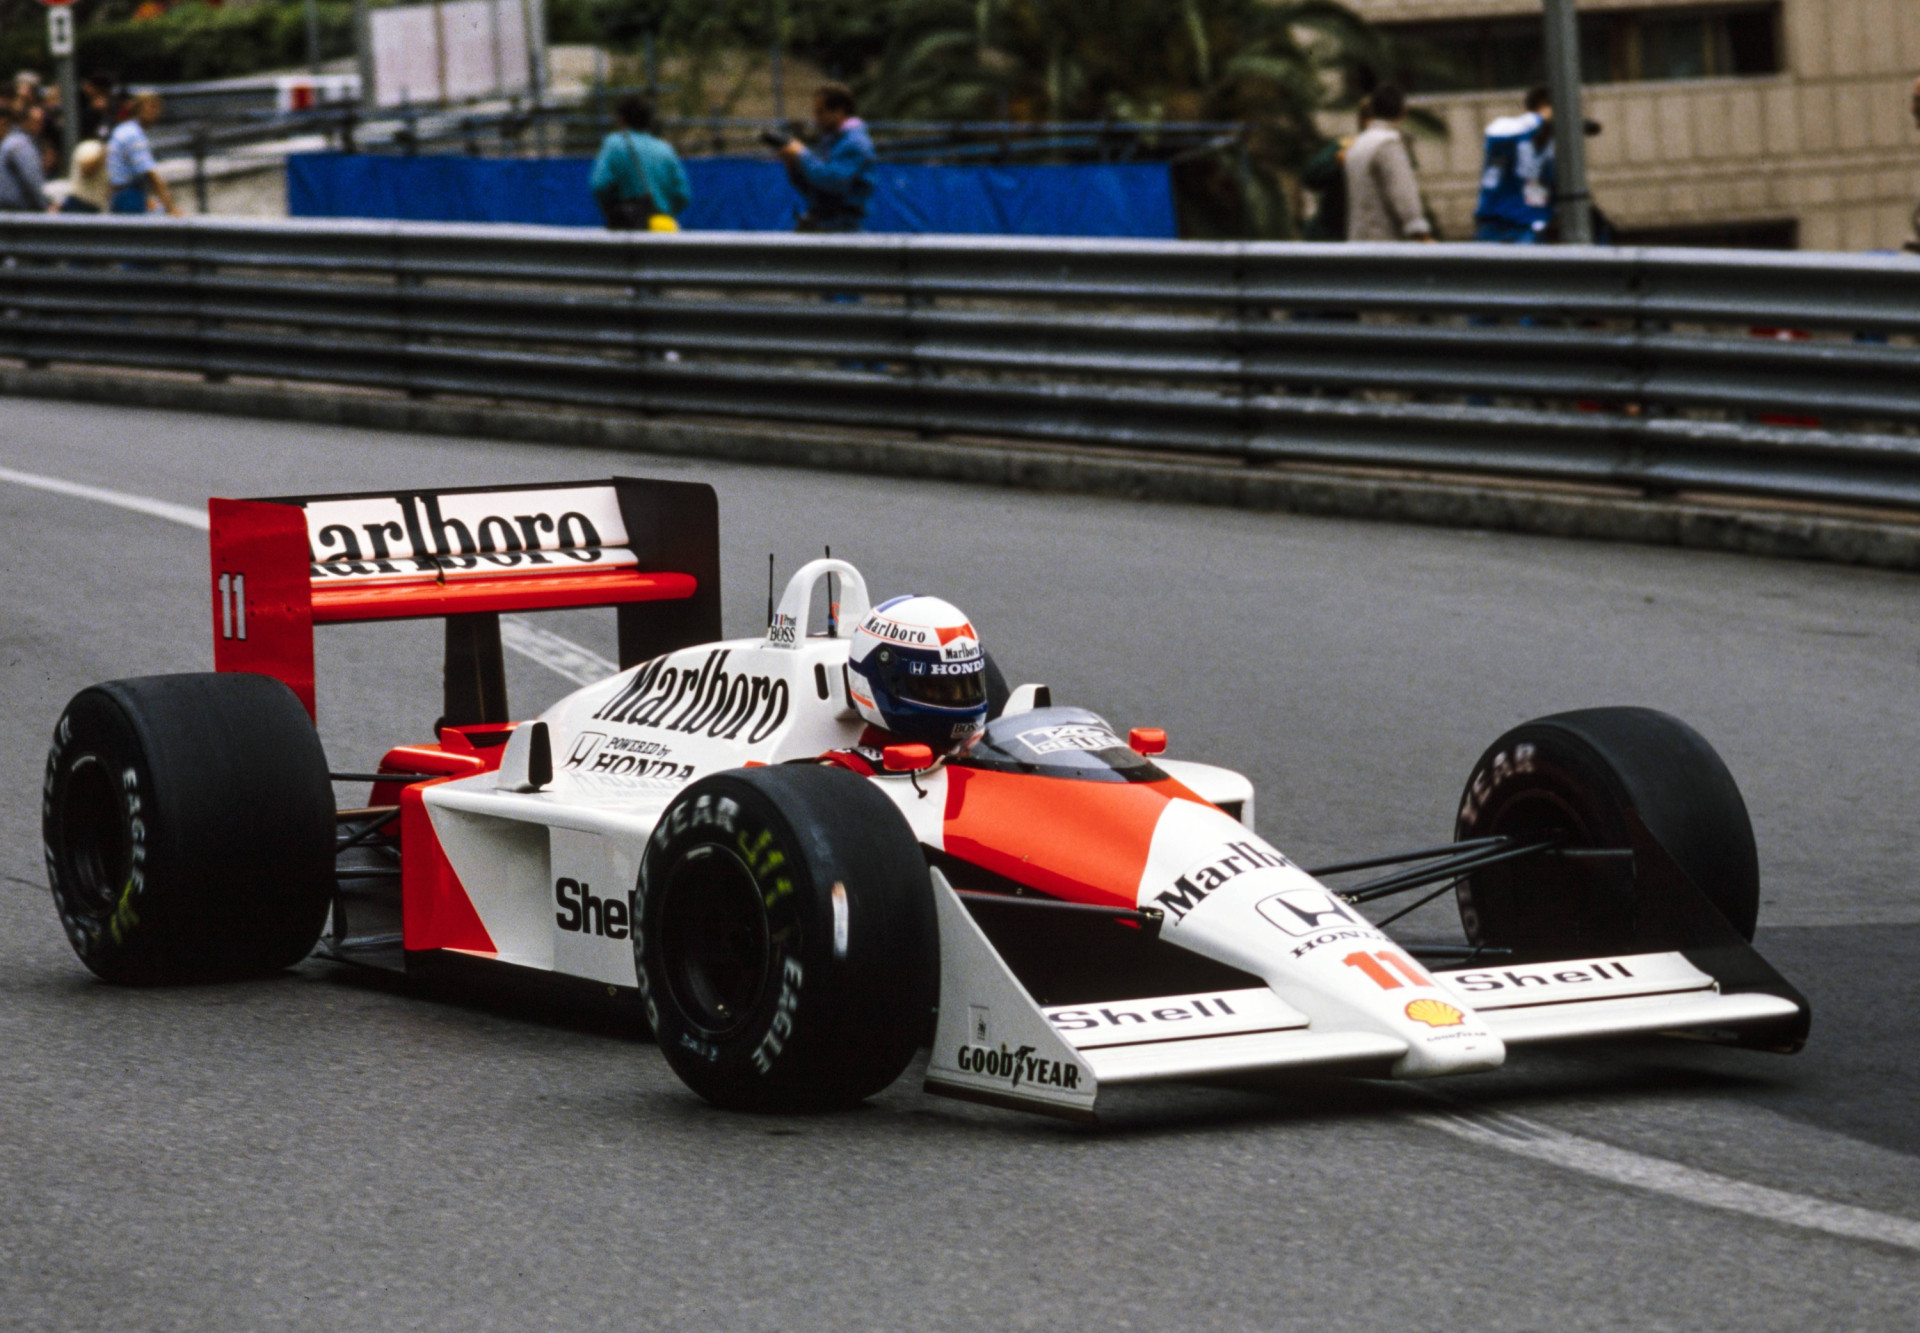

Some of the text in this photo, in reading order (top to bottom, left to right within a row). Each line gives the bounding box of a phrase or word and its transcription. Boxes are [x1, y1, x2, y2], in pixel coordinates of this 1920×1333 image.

[308, 496, 603, 577] arlboro
[218, 572, 247, 640] 11
[770, 625, 796, 643] BOSS
[866, 616, 926, 643] Marlboro
[592, 650, 789, 744] Marlboro
[605, 737, 672, 759] POWERED by
[590, 752, 696, 782] HONDA
[1342, 951, 1435, 991] 11
[1455, 962, 1635, 992] Shell
[752, 956, 803, 1076] EAGLE
[1049, 998, 1238, 1031] Shell
